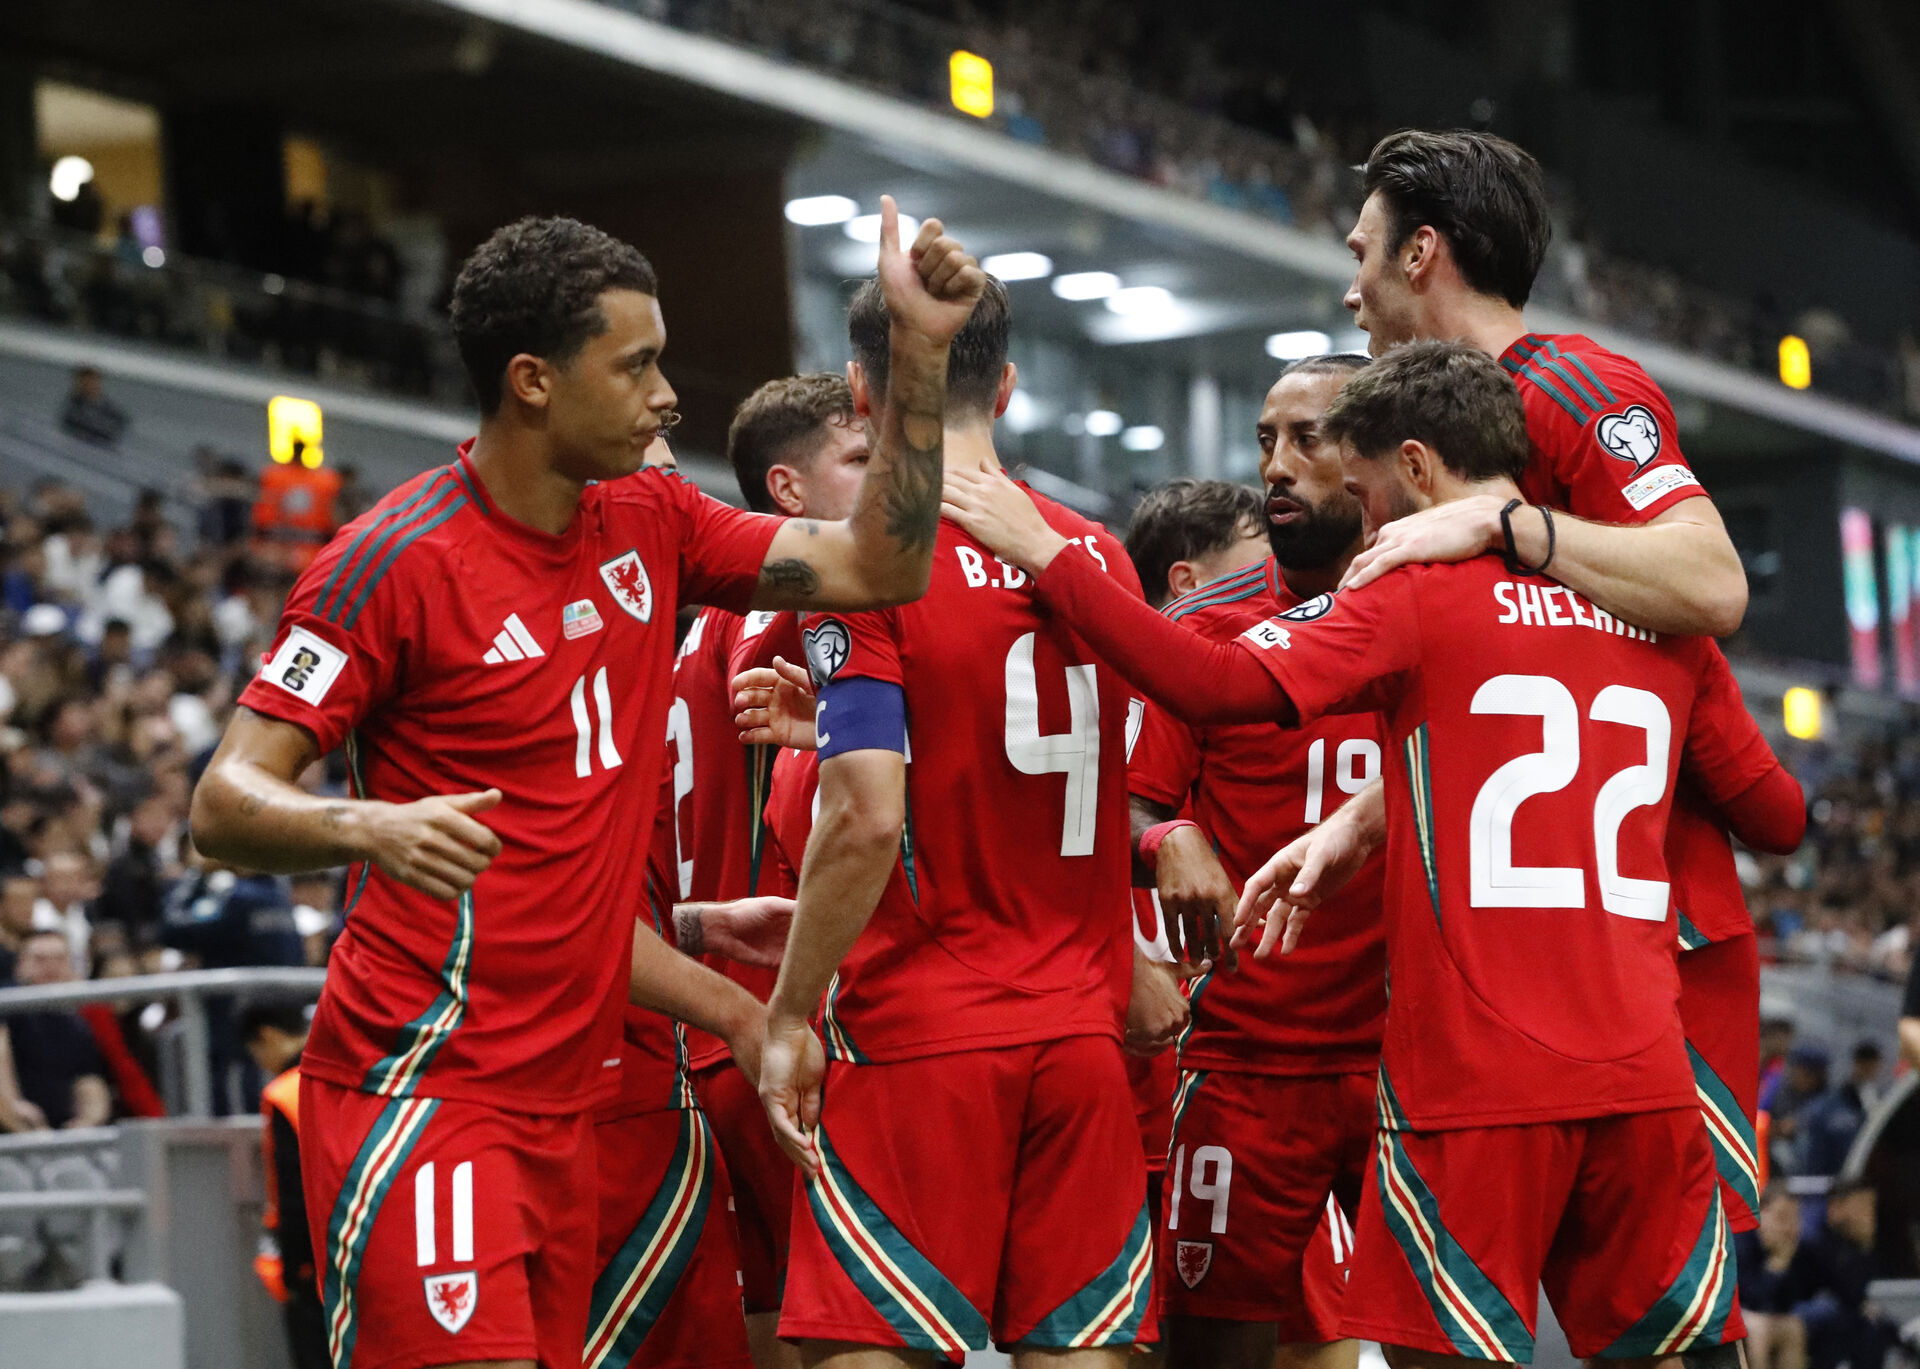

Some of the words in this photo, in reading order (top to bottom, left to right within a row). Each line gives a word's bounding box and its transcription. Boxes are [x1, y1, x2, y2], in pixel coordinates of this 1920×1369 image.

[955, 535, 1108, 589] B.DS
[1493, 581, 1657, 644] SHEEH
[570, 665, 623, 779] 11
[1005, 631, 1100, 857] 4
[1469, 673, 1672, 922] 22
[415, 1160, 475, 1268] 11
[1168, 1143, 1233, 1235] 19
